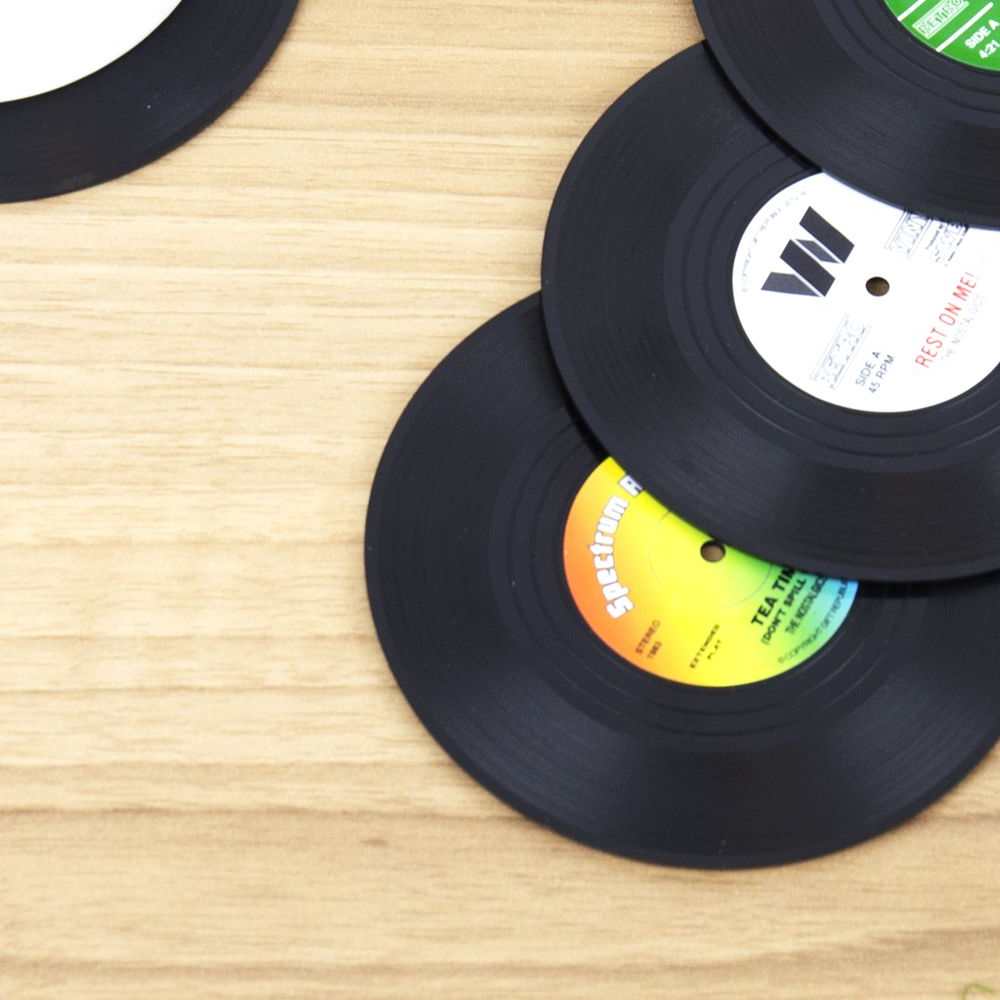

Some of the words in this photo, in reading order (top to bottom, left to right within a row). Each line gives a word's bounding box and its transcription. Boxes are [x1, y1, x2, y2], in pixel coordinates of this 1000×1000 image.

[964, 25, 992, 49] SIDE
[988, 19, 1000, 30] A
[915, 326, 947, 368] REST
[938, 302, 962, 326] ON
[855, 361, 876, 386] SIDE
[871, 351, 881, 359] A
[868, 381, 881, 393] 45
[875, 354, 895, 379] RPM
[588, 495, 634, 619] Spectrum
[784, 579, 806, 607] SPILL
[751, 597, 778, 626] TEA
